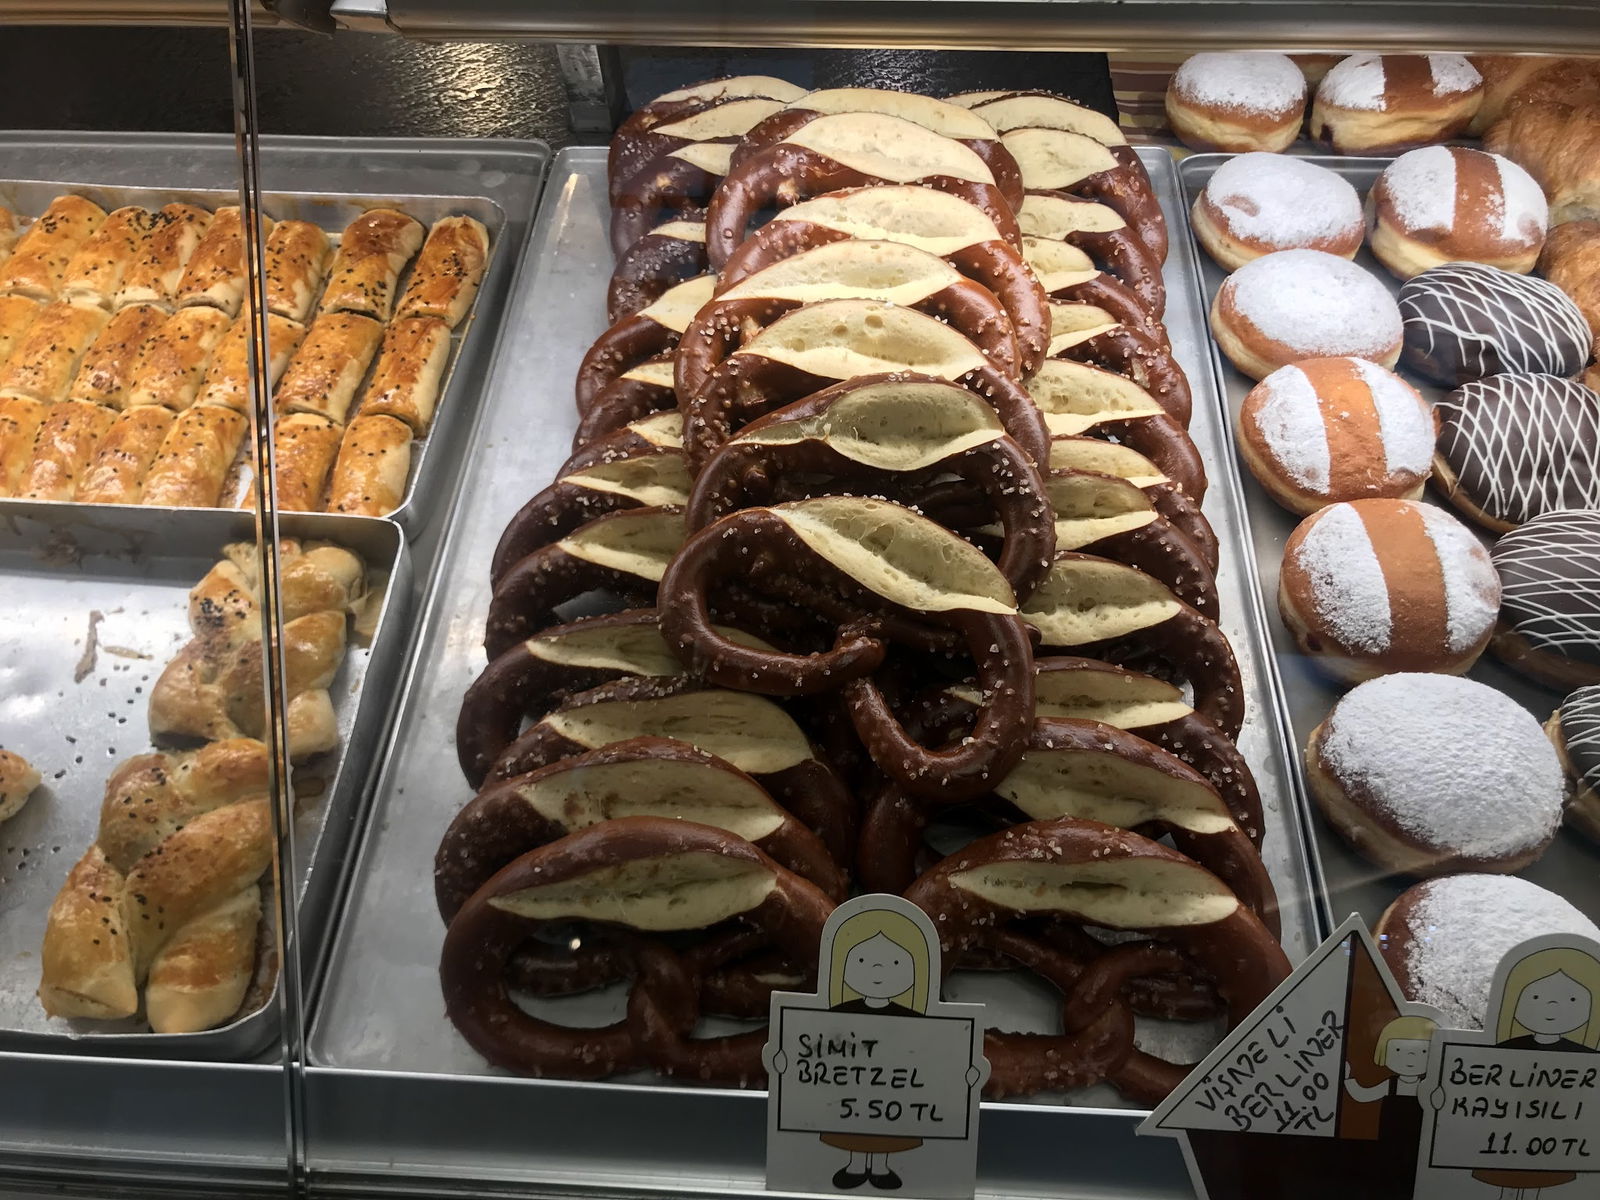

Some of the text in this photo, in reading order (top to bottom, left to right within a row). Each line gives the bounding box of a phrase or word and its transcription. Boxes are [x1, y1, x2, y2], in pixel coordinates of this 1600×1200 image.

[797, 1059, 924, 1088] BRETZEL
[839, 1098, 943, 1122] 5.50 TL
[1294, 1105, 1334, 1130] TL
[1452, 1096, 1583, 1120] KAYISILI
[1479, 1131, 1590, 1157] 11.00 TL
